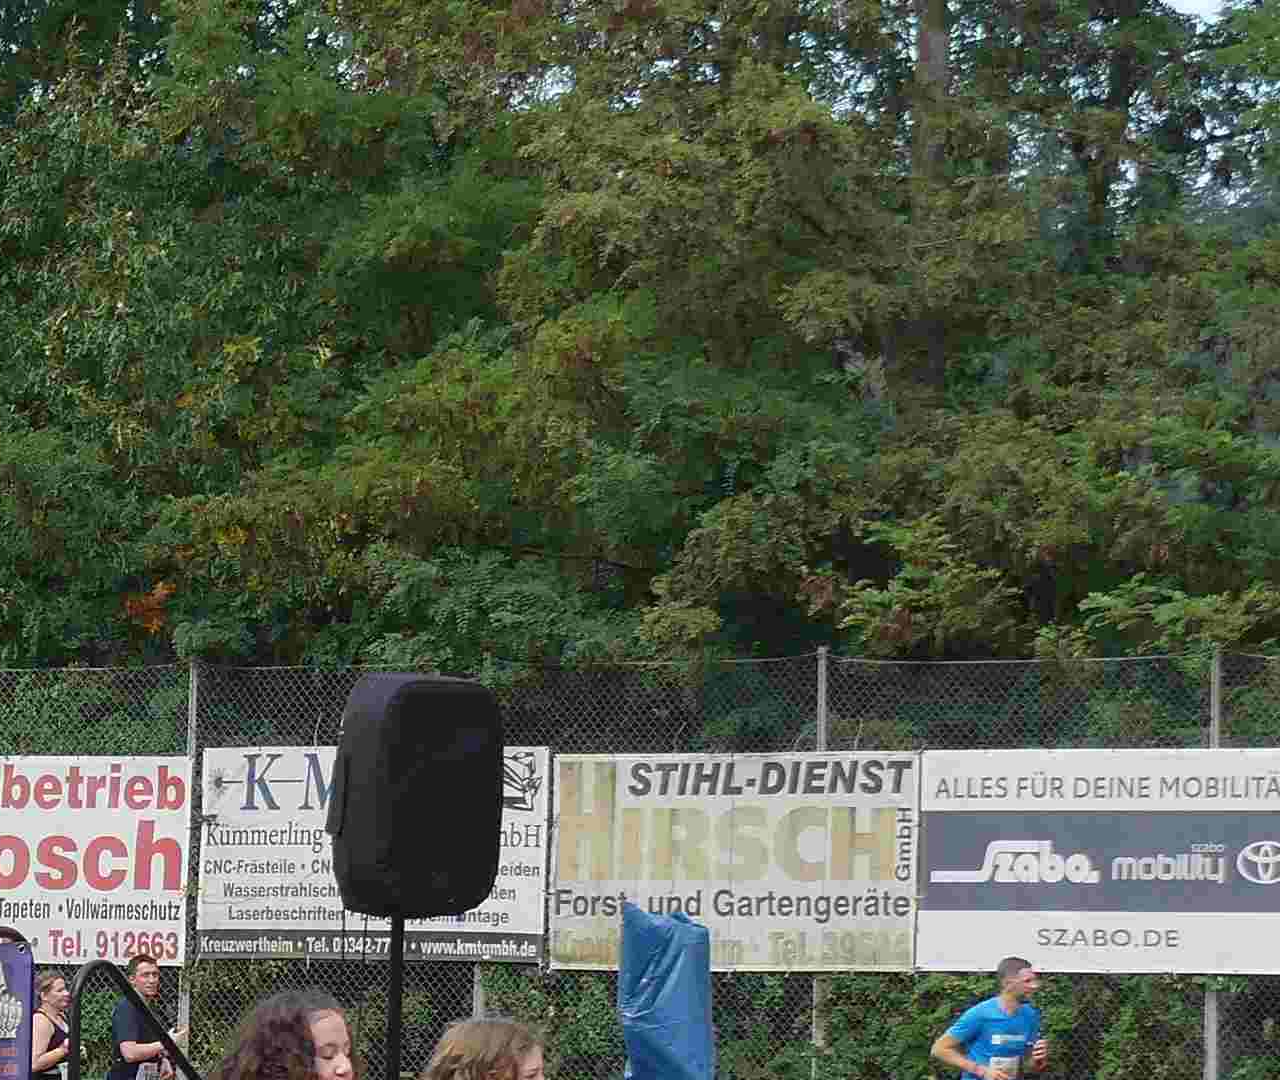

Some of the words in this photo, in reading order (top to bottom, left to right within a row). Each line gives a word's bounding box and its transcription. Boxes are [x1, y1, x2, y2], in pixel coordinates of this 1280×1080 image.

[627, 760, 913, 797] STIHL-DIENST
[936, 776, 1008, 799] ALLES
[1015, 772, 1065, 799] FÜR
[1072, 776, 1152, 799] DEINE
[559, 762, 897, 880] HIRSCH
[206, 824, 324, 853] Kümmerling
[895, 806, 913, 881] GmbH
[203, 859, 296, 876] CNC-Frästeile
[1111, 853, 1225, 883] mobility
[66, 899, 181, 922] Vollwärmeschutz
[648, 889, 702, 916] und
[712, 888, 911, 923] Gartengeräte
[47, 930, 87, 959] Tel.
[95, 931, 179, 960] 912663
[200, 935, 293, 953] Kreuzwertheim
[306, 936, 331, 952] Tel.
[420, 939, 537, 958] www.kmtgmbh.de
[1036, 928, 1181, 947] SZABO.DE
